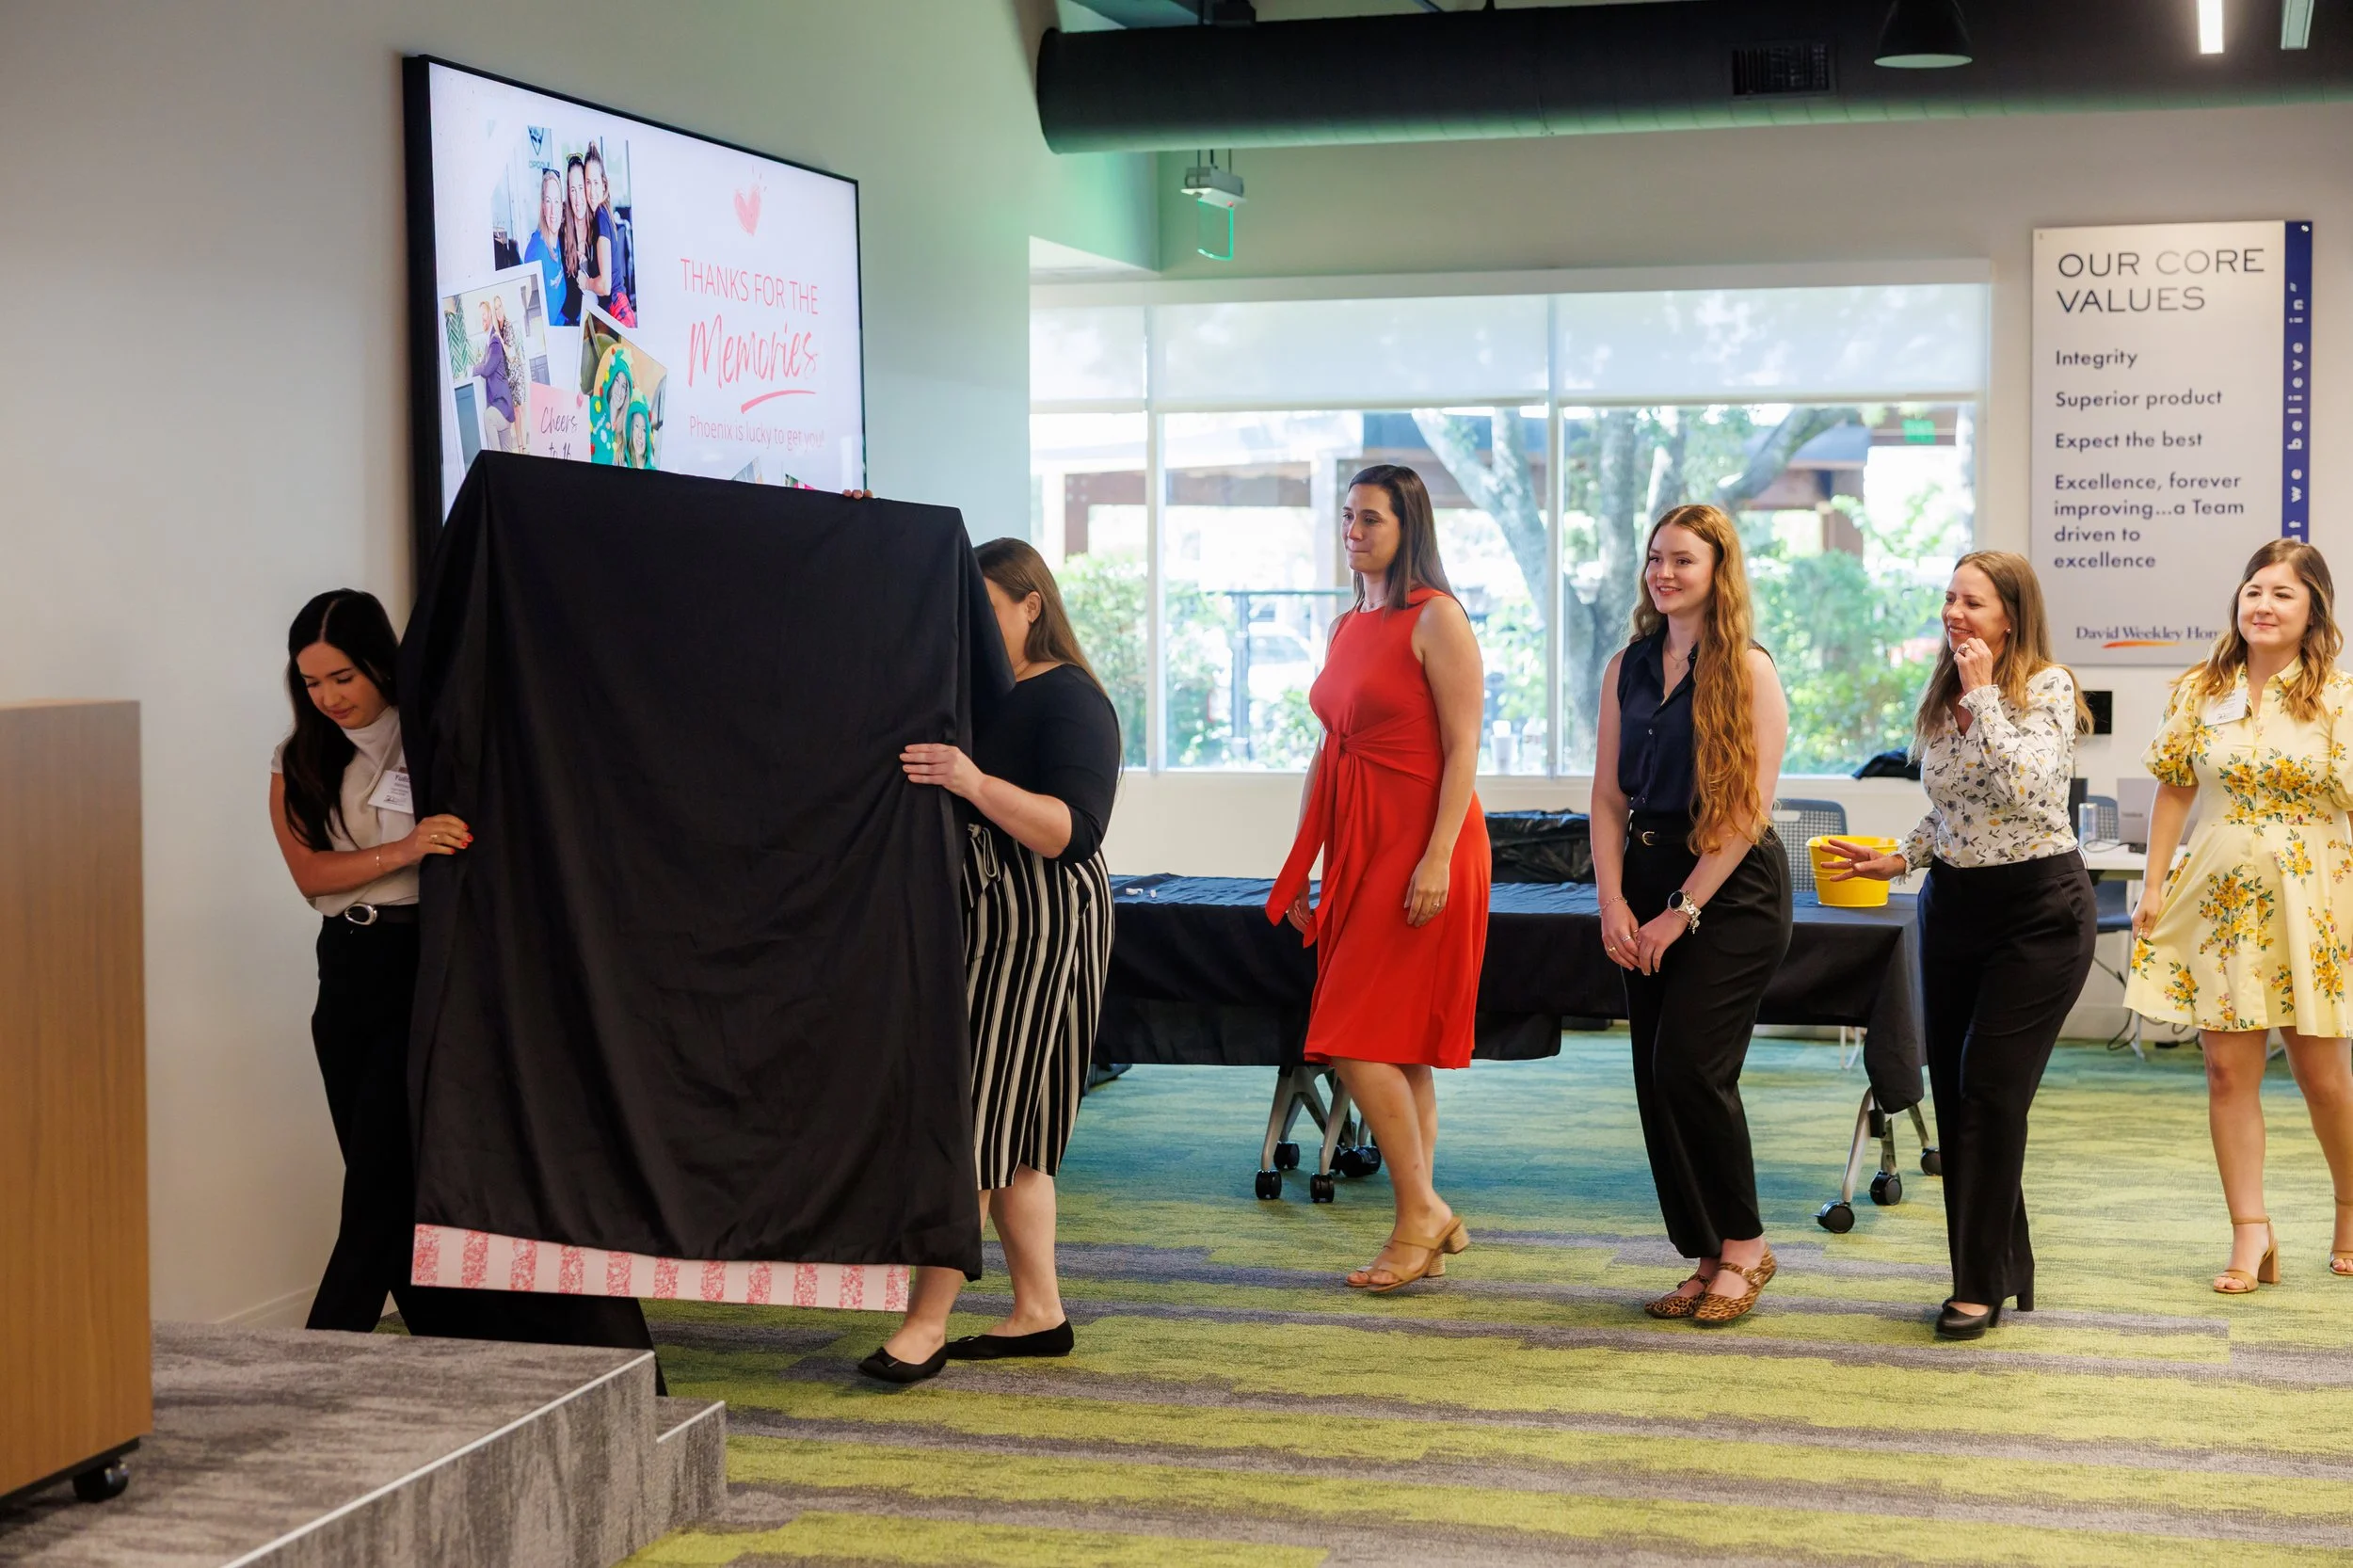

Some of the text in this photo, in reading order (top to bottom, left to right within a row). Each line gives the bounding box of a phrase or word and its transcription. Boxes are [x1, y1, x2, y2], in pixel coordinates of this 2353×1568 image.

[2057, 248, 2265, 278] OUR CORE
[680, 258, 819, 315] THANKS FOR THE
[2057, 286, 2206, 313] VALUES
[688, 313, 820, 390] Memories
[2056, 349, 2138, 369] Integrity
[2056, 389, 2223, 410] Superior product
[2287, 342, 2303, 450] believe
[541, 407, 578, 434] Cheers
[689, 415, 733, 440] Phoenix
[735, 420, 744, 441] is
[745, 421, 771, 449] lucky
[774, 427, 784, 444] to
[787, 429, 801, 451] get
[2056, 431, 2202, 452] Expect the best
[2055, 472, 2242, 491] Excellence, forever
[2192, 499, 2245, 516] Team
[2055, 525, 2140, 543] driven to
[2055, 551, 2156, 568] excellence
[2075, 626, 2218, 642] David Weekley Hom
